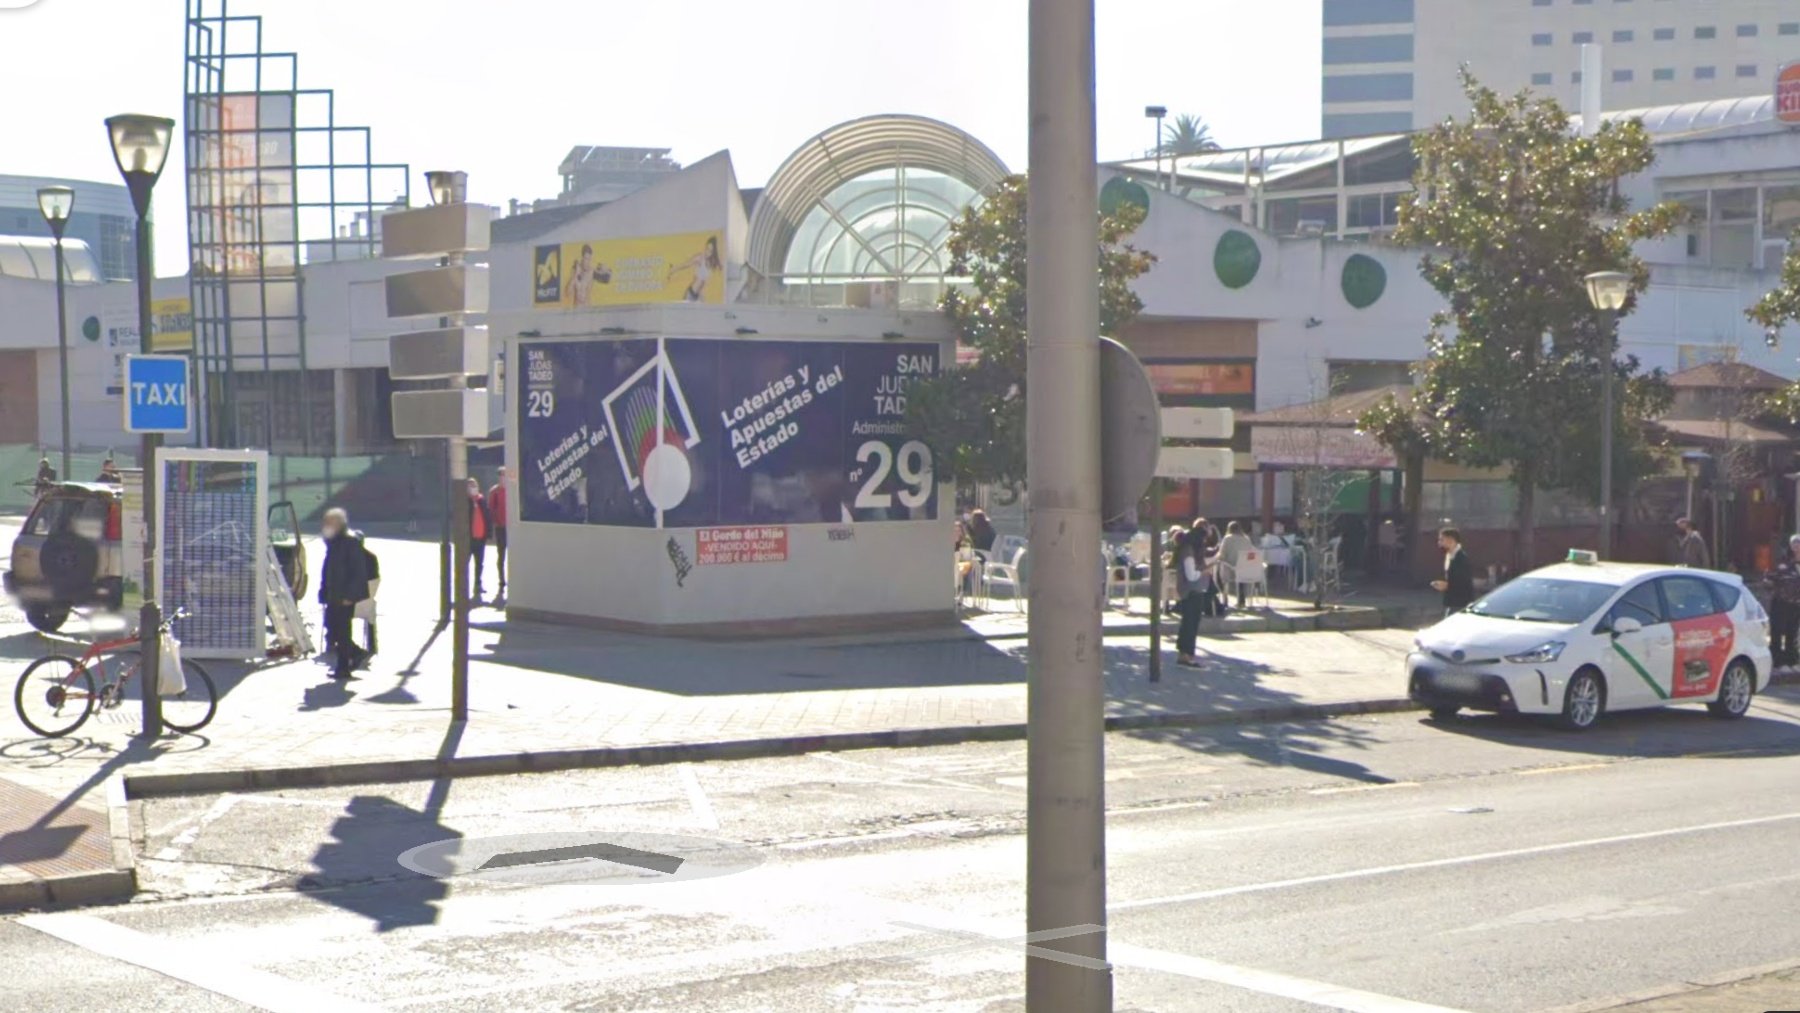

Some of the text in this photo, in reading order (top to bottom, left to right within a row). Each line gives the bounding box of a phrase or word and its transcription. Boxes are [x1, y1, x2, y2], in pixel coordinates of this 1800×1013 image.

[528, 351, 545, 361] SAN
[528, 361, 553, 371] JUDAS
[897, 354, 933, 374] SAN
[528, 371, 553, 382] TADEO
[131, 382, 186, 406] TAXI
[528, 391, 554, 418] 29
[721, 364, 811, 429] Loterías y
[874, 396, 909, 415] TAD
[730, 364, 844, 450] Apuestas del
[579, 424, 588, 438] y
[543, 424, 608, 487] Apuestas del
[735, 421, 799, 469] Estado
[547, 466, 582, 500] Estado
[855, 440, 934, 508] 29
[699, 528, 784, 541] El Gordo del Niño
